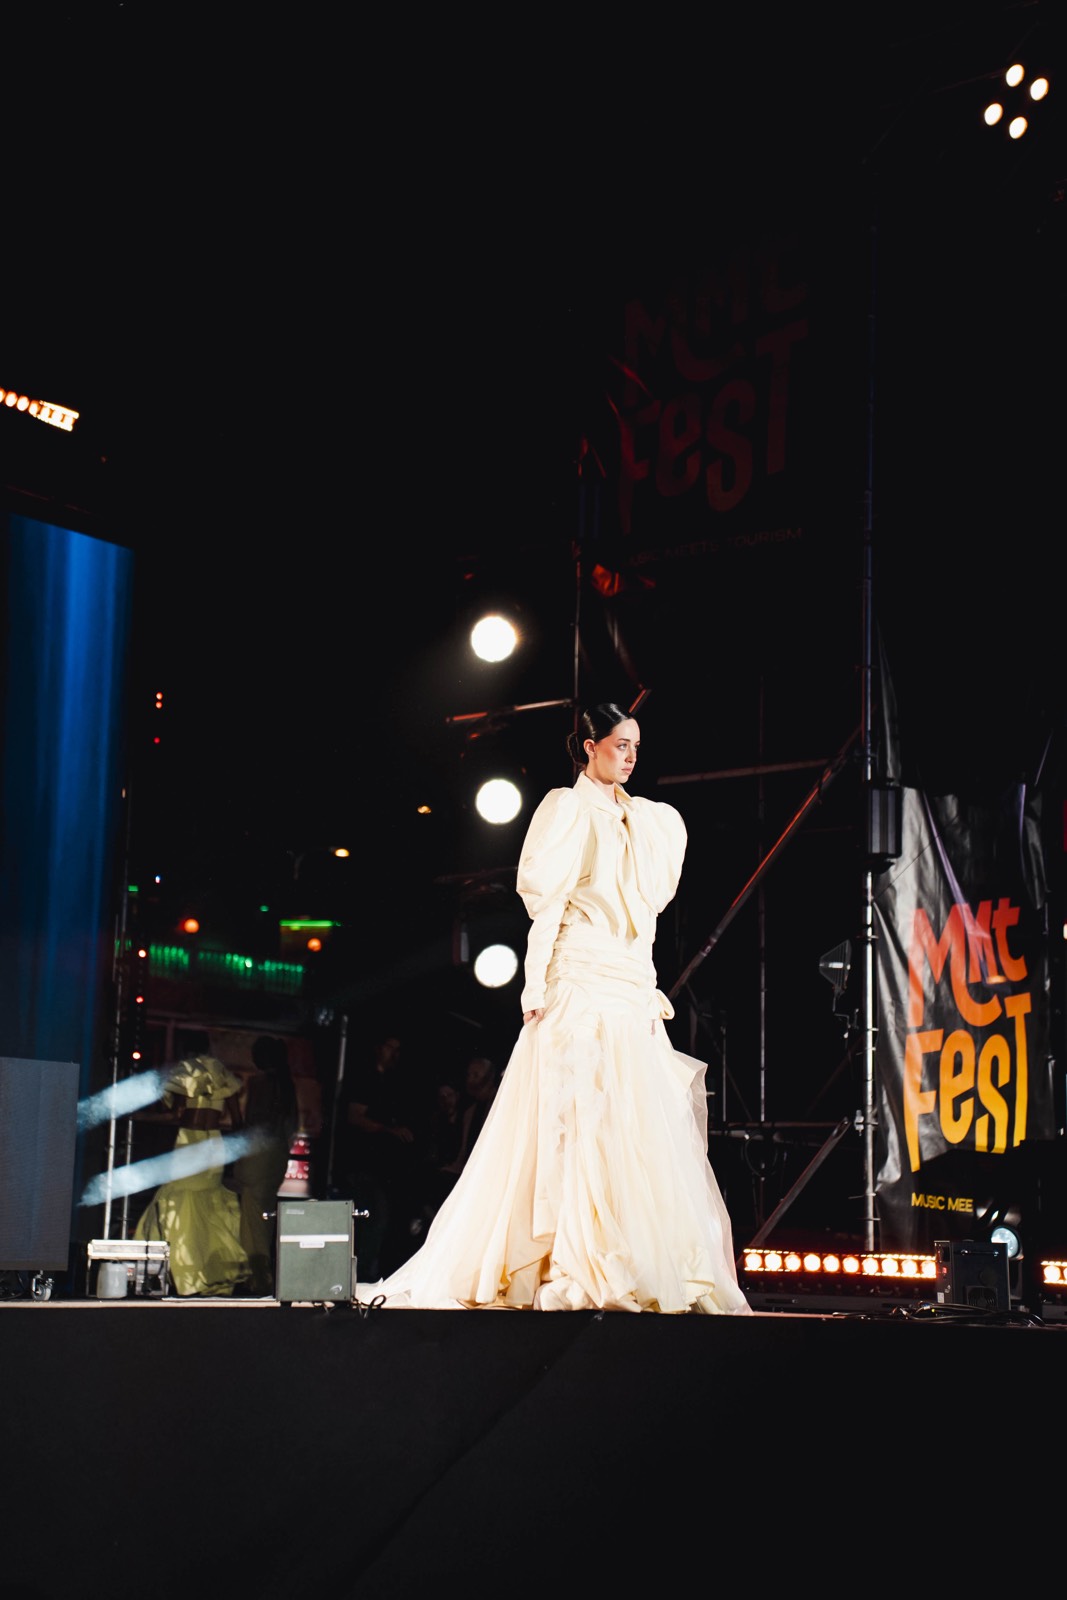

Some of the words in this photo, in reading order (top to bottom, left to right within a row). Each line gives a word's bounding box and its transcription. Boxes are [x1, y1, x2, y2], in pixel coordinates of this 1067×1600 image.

[727, 527, 802, 548] TOURISM
[911, 1192, 945, 1210] MUSIC
[947, 1197, 974, 1213] MEE
